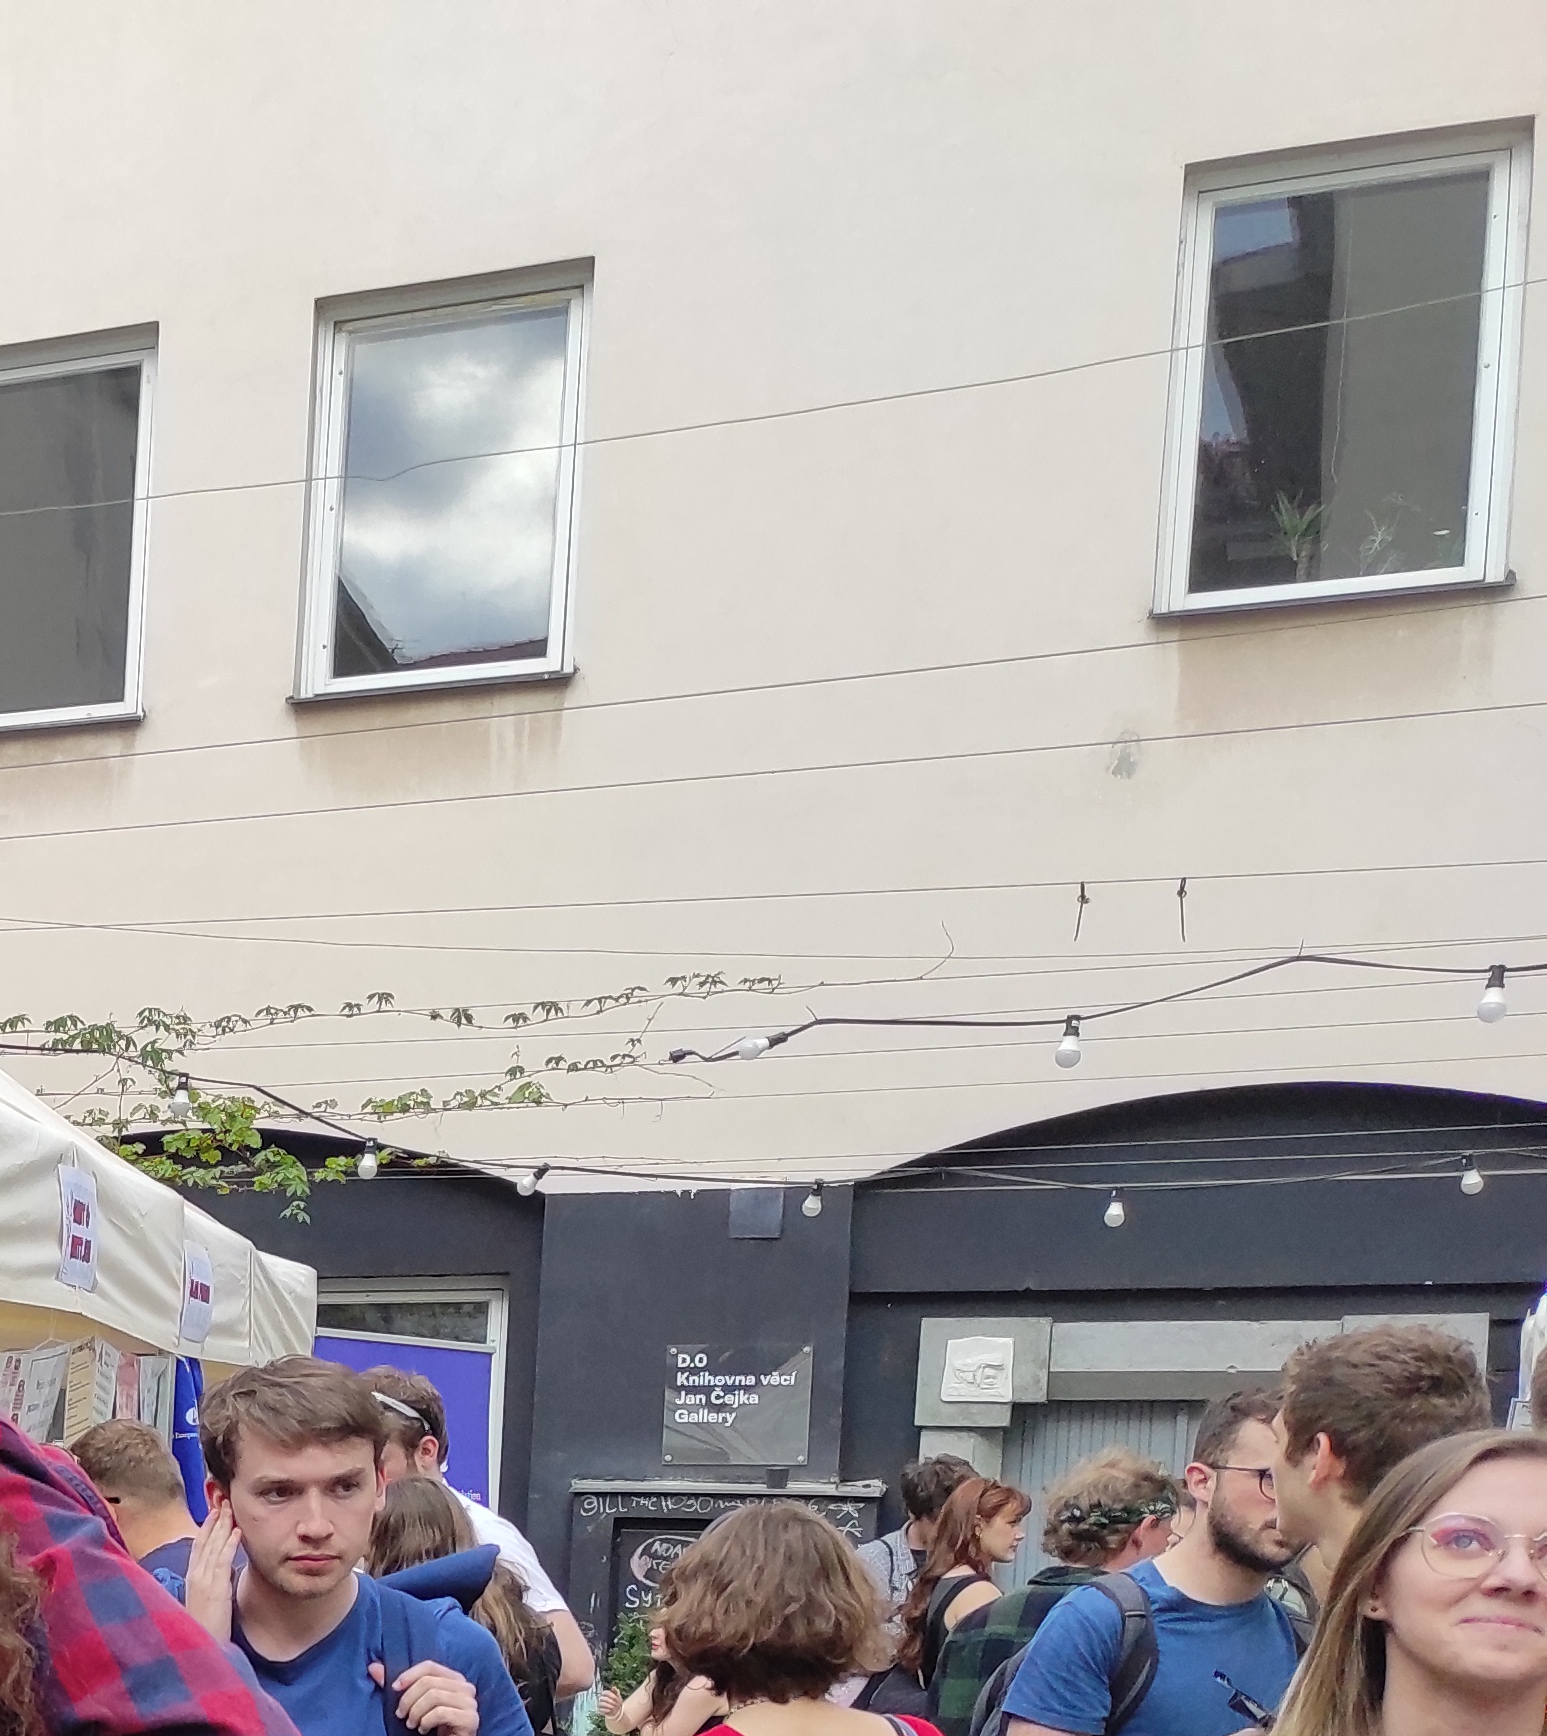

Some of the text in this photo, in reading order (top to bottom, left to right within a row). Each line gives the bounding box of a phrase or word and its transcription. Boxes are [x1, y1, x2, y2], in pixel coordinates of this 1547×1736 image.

[676, 1371, 797, 1386] Knihovna věcí
[675, 1387, 759, 1408] Jan Čejka
[674, 1408, 736, 1427] Gallery
